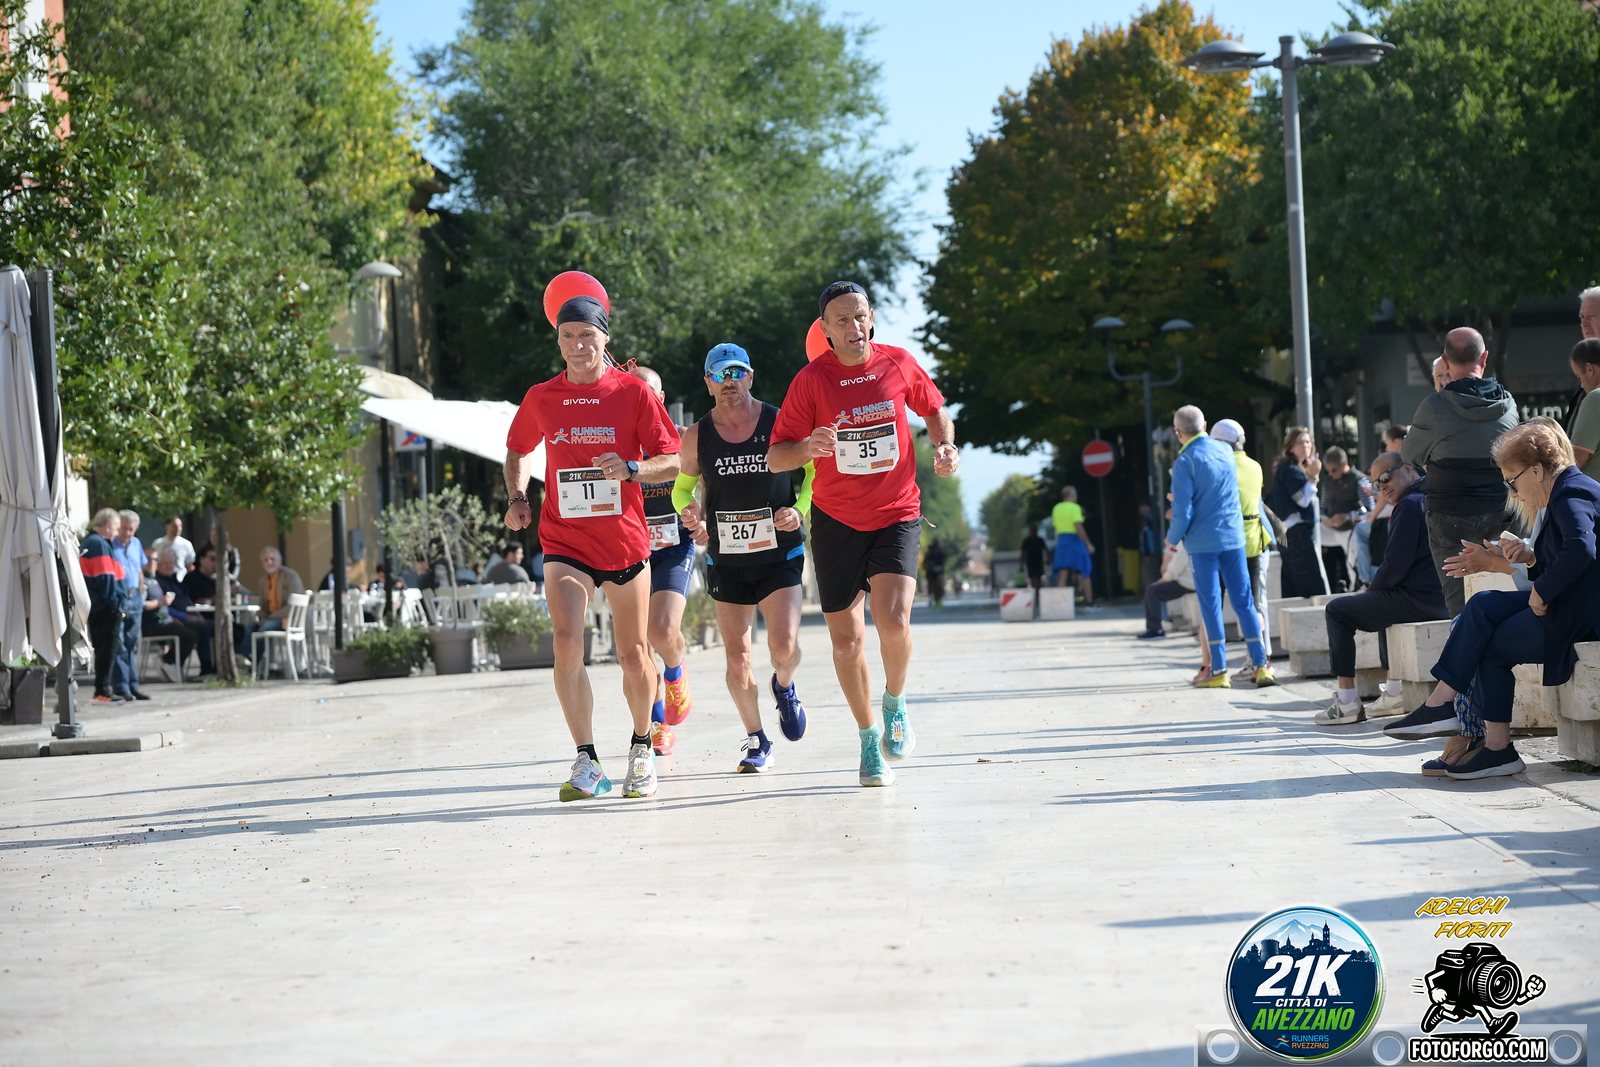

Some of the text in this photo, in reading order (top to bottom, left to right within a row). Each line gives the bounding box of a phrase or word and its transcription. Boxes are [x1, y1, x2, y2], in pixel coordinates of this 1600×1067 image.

[840, 374, 877, 387] GIVOVA
[563, 398, 600, 406] GIVOVA
[852, 400, 895, 417] RUNNERS
[853, 408, 896, 425] AVEZZANO
[570, 426, 615, 436] RUNNERS
[846, 432, 862, 440] 21K
[570, 436, 616, 445] AVEZZANO
[858, 440, 878, 459] 35
[718, 463, 769, 476] CARSOLI
[568, 472, 582, 481] 21K
[582, 482, 595, 500] 11
[725, 514, 738, 522] 21K
[731, 523, 758, 540] 267
